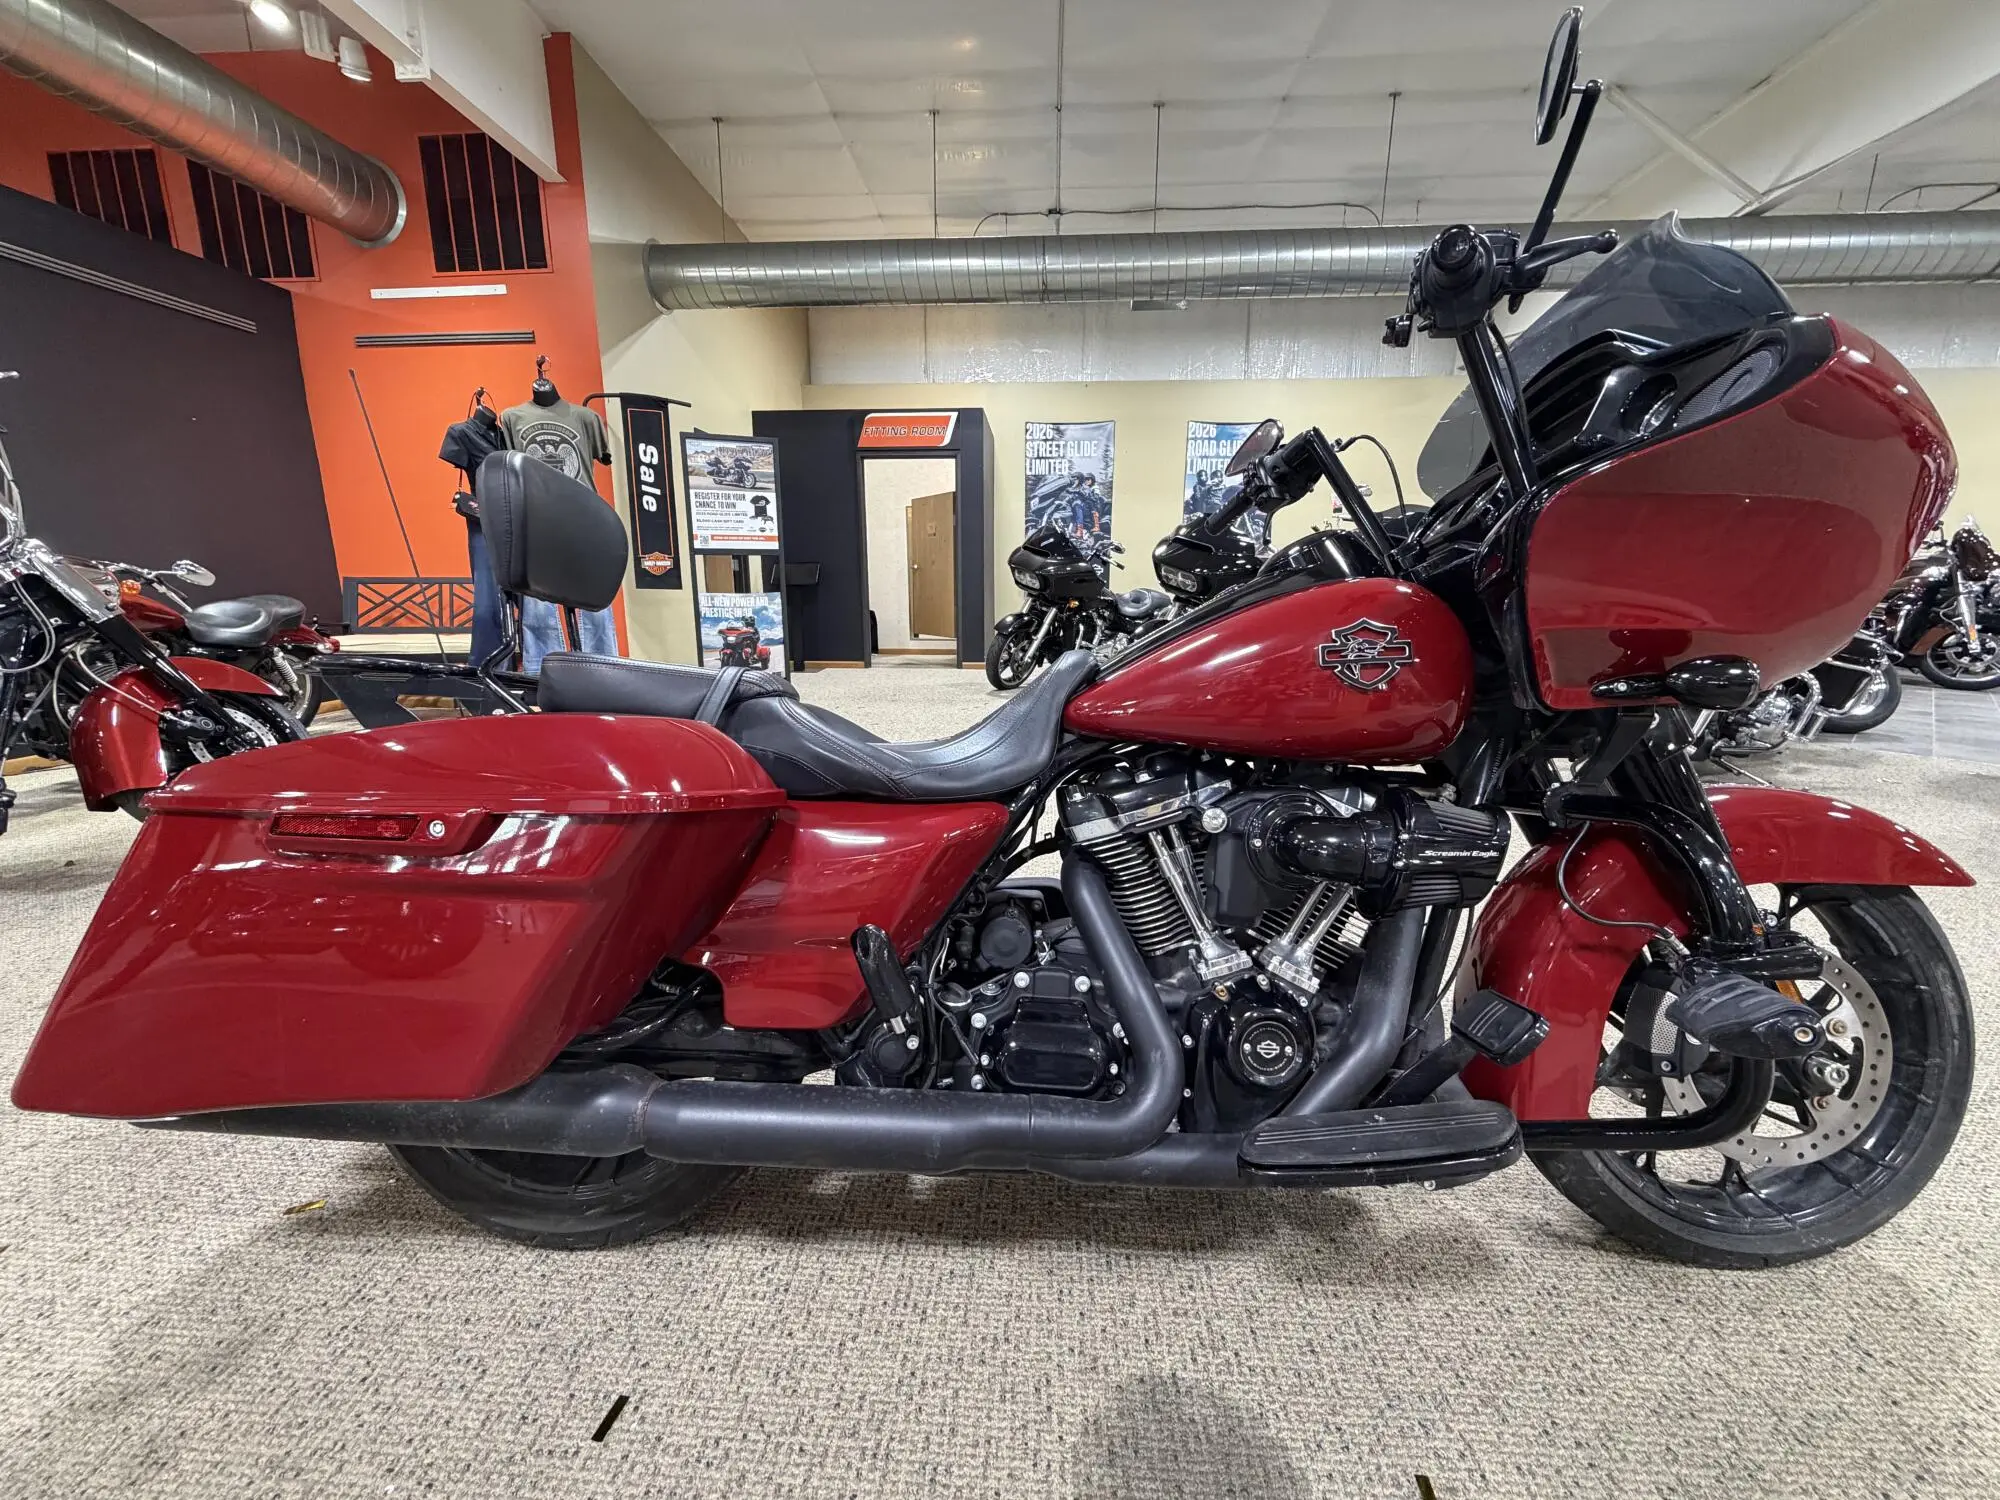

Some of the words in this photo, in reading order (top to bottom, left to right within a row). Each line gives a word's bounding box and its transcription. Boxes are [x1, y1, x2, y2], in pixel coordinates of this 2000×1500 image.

[864, 426, 906, 436] FITTING
[911, 426, 946, 436] ROOM
[1026, 422, 1053, 440] 2026
[1189, 422, 1216, 438] 2026
[1026, 440, 1065, 458] STREET
[1067, 440, 1098, 457] GLIDE
[1188, 440, 1216, 457] ROAD
[1026, 458, 1068, 475] LIMITED
[638, 442, 661, 512] Sale
[694, 492, 720, 500] REGISTER
[700, 596, 730, 607] ALL-NEW
[731, 596, 755, 607] POWER
[756, 597, 768, 607] AND
[702, 608, 733, 618] PRESTIGE
